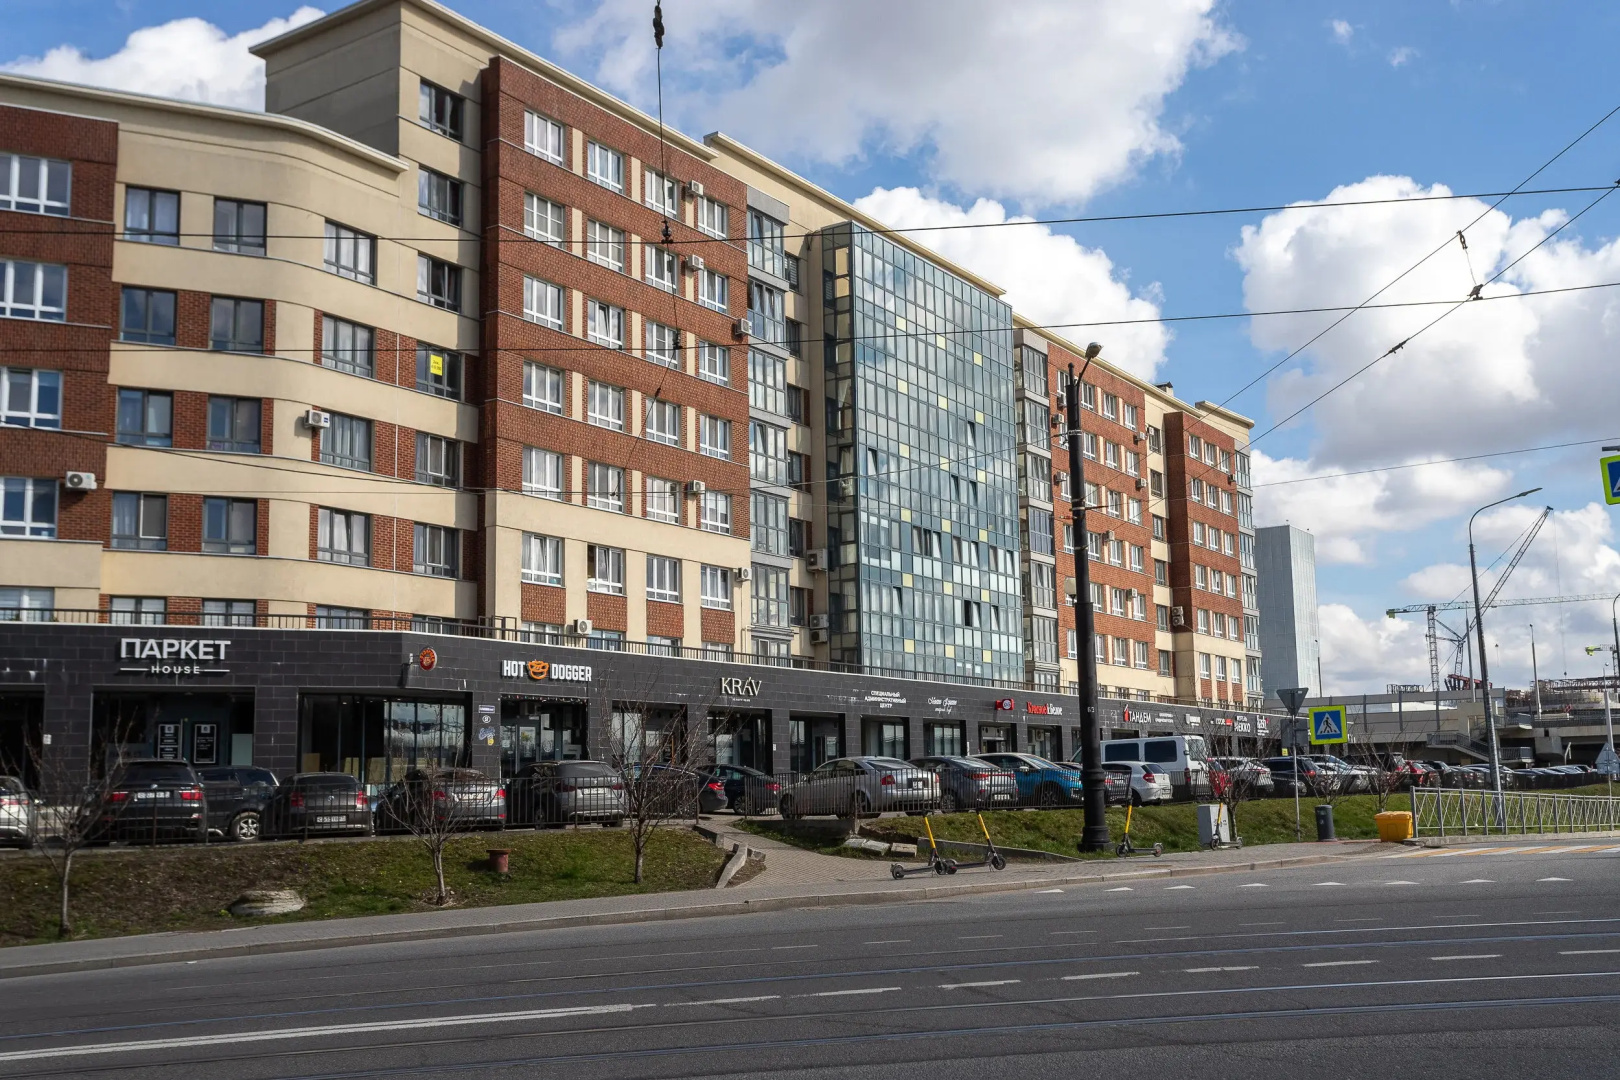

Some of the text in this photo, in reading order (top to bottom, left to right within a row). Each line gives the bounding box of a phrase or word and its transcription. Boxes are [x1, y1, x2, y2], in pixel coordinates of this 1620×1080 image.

[120, 638, 231, 660] ПАРКЕТ
[151, 665, 200, 674] HOUSE
[502, 660, 592, 682] HOT DOGGER
[721, 676, 762, 697] KRÁV
[1129, 711, 1152, 724] ТАНДЕМ
